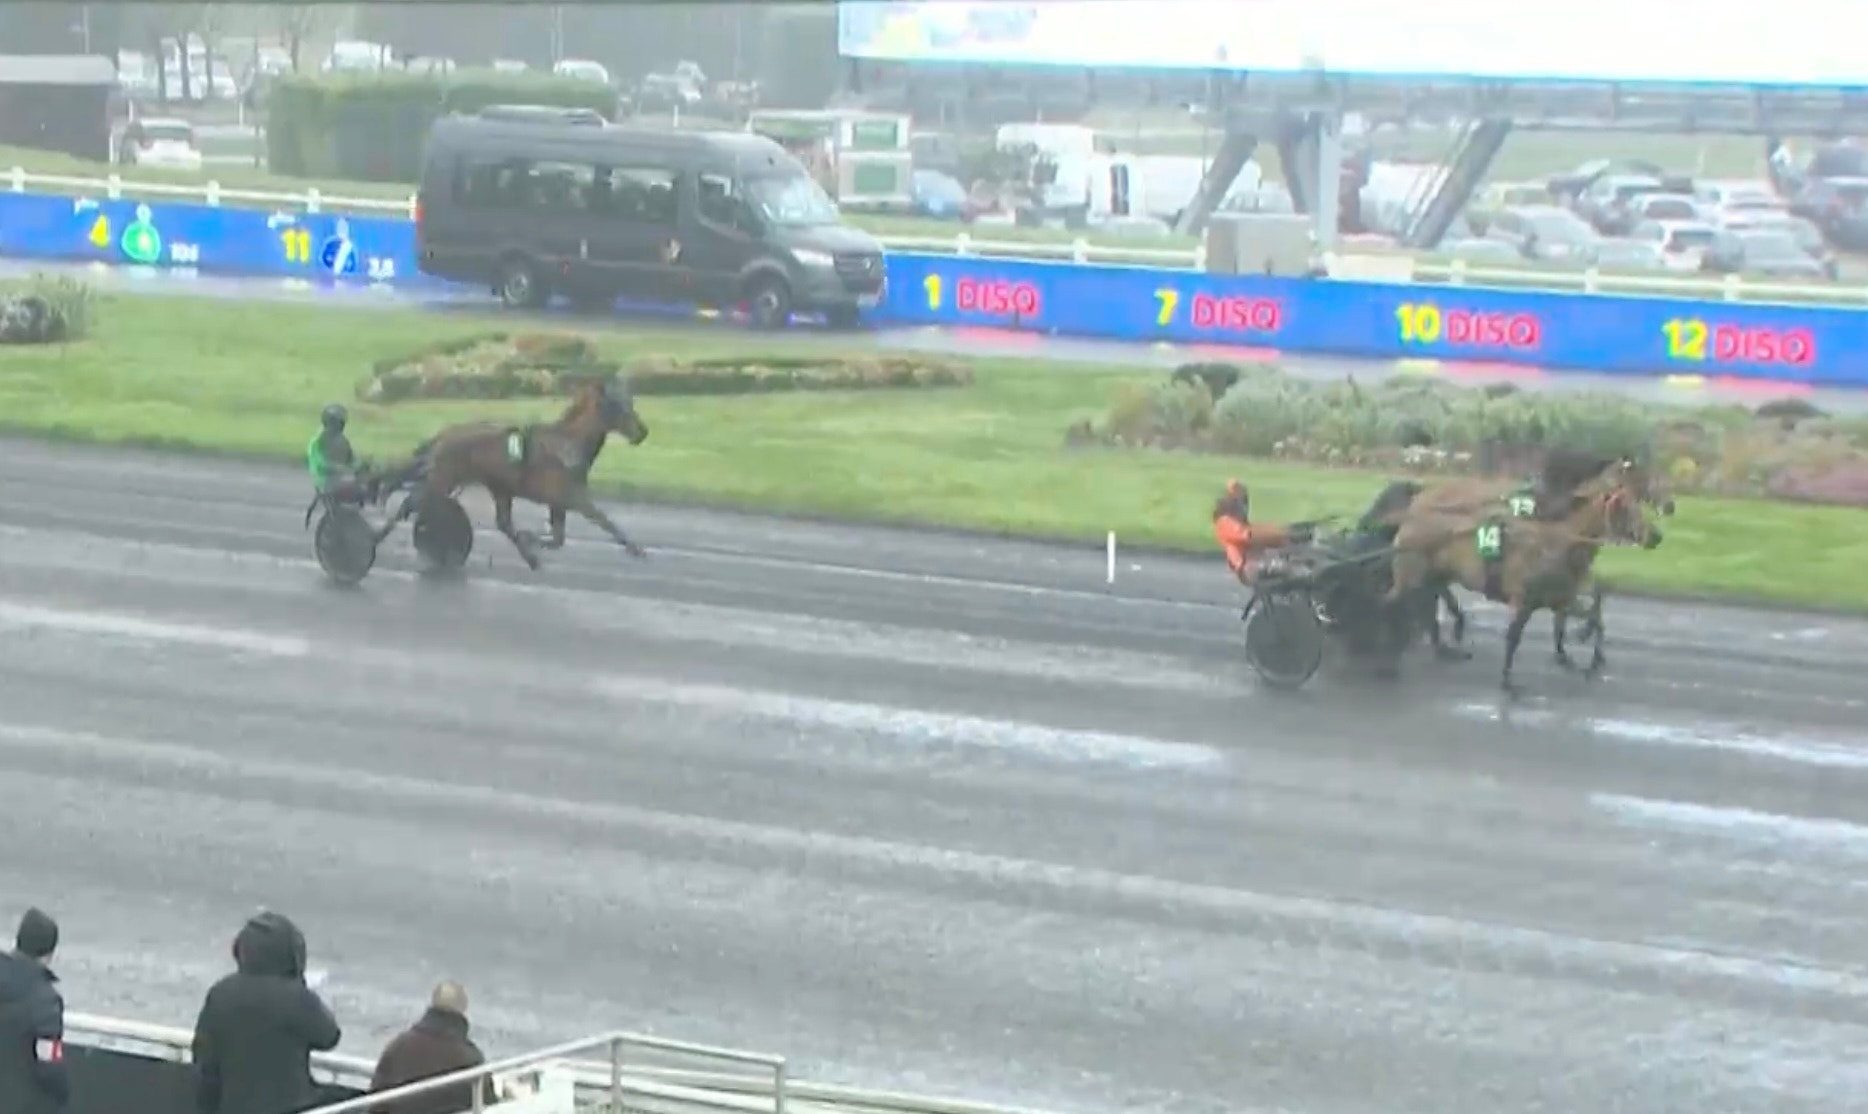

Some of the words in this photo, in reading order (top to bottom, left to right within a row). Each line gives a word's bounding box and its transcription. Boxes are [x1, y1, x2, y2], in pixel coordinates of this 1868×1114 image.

[90, 214, 109, 248] 4
[281, 228, 310, 263] 11
[923, 273, 941, 311] 1
[957, 279, 1040, 316] DISQ
[1154, 289, 1178, 325] 7
[1193, 294, 1281, 331] DISQ
[1396, 303, 1441, 343] 10
[1447, 309, 1540, 348] DISQ
[1663, 319, 1707, 360] 12
[1714, 326, 1815, 366] DISQ
[1477, 526, 1500, 551] 14
